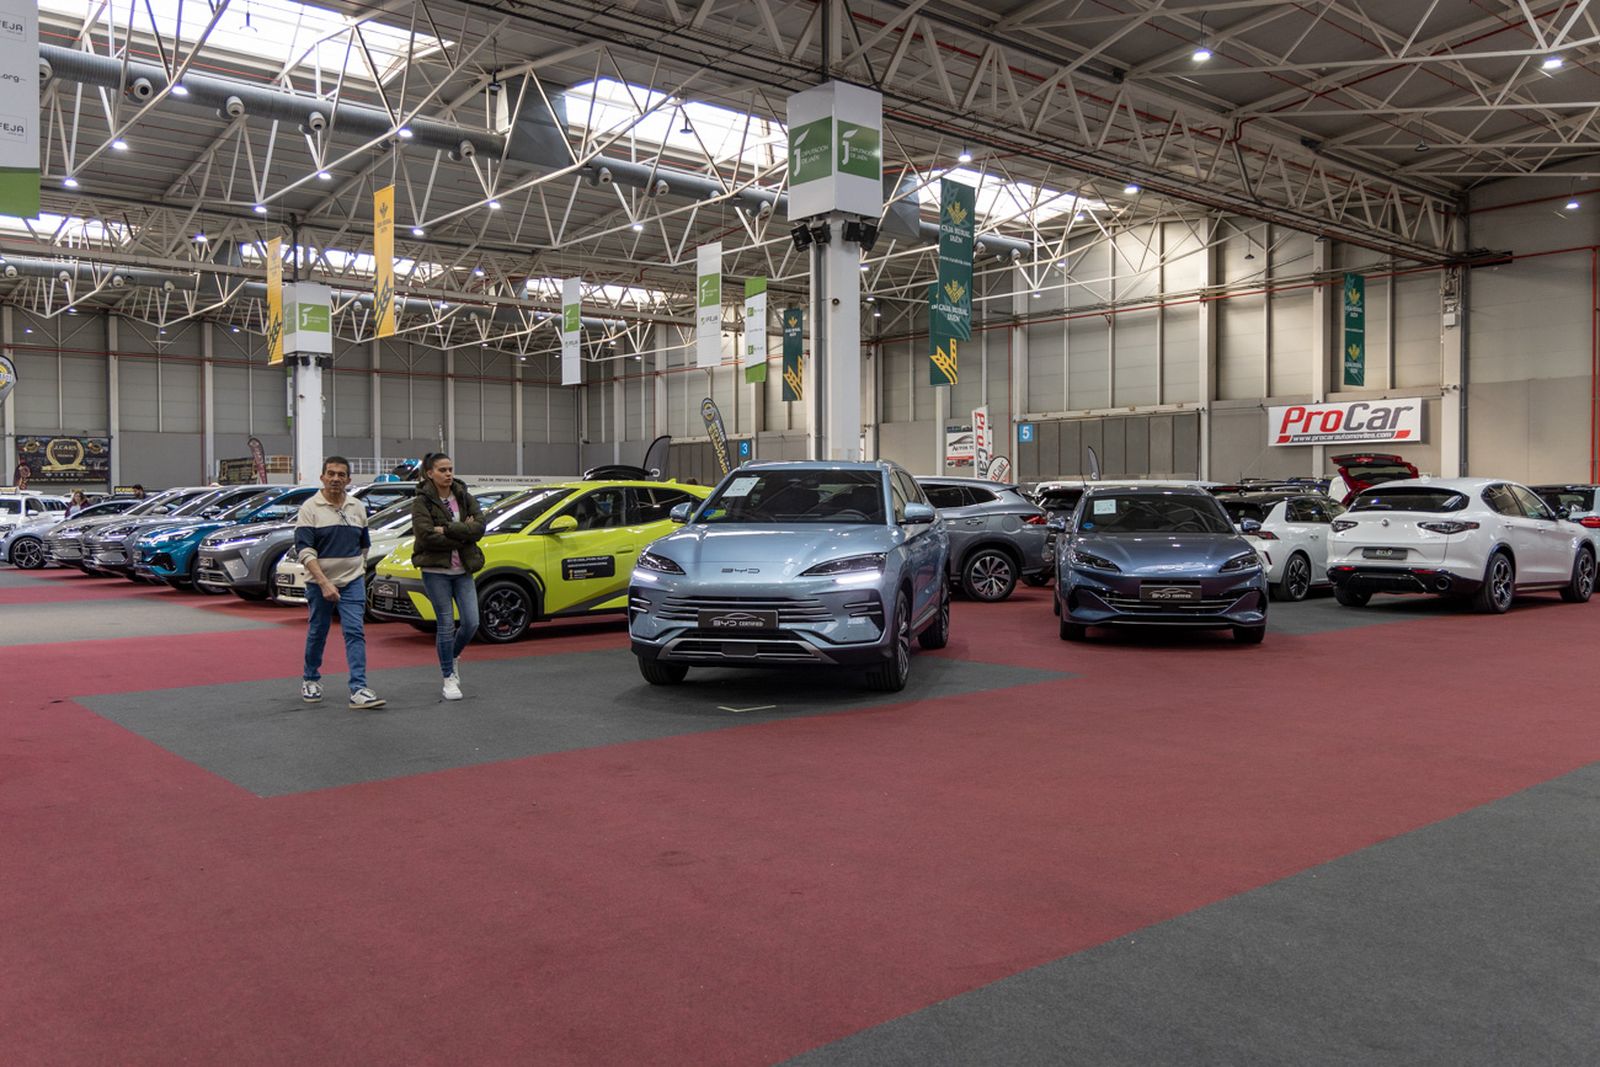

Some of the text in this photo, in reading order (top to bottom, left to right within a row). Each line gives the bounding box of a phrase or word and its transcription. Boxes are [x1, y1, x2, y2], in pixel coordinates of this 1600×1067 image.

[1279, 403, 1414, 434] ProCar
[1022, 426, 1030, 439] 5
[742, 442, 748, 454] 3
